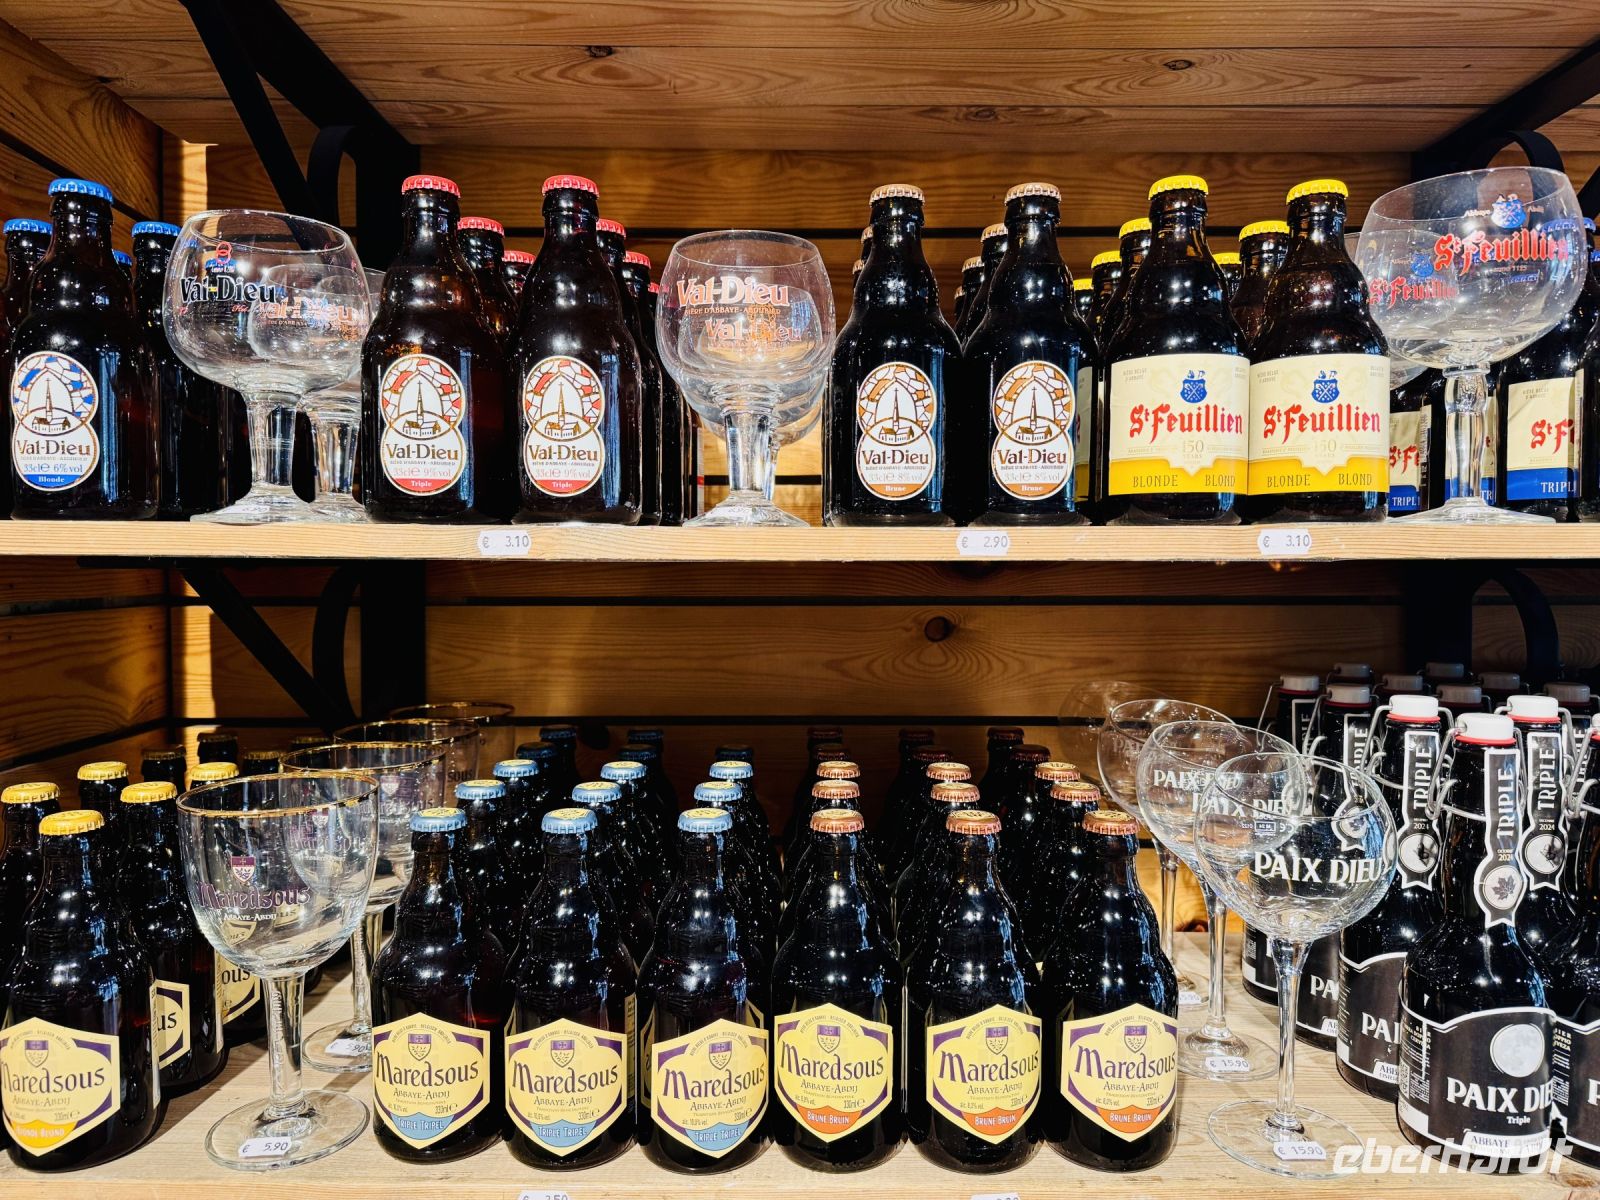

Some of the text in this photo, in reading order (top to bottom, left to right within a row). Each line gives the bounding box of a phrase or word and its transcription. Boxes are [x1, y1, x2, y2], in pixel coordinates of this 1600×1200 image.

[1458, 228, 1569, 276] Feuillien
[180, 275, 275, 303] Val-Dieu
[677, 276, 789, 307] Val-Dieu
[1150, 404, 1242, 444] Feuillien
[1282, 404, 1380, 444] Feuillien
[17, 440, 90, 455] Val-Dieu
[386, 444, 458, 460] Val-Dieu
[529, 445, 598, 461] Val-Dieu
[862, 450, 929, 464] Val-Dieu
[998, 449, 1066, 464] Val-Dieu
[69, 465, 83, 473] vol
[1133, 475, 1236, 488] BLONDE BLOND
[1267, 473, 1372, 488] BLONDE BLOND
[1540, 481, 1576, 494] TRIPL
[1391, 496, 1420, 506] TRIPL
[482, 535, 529, 548] € 3.10
[961, 536, 1008, 548] € 2.90
[1263, 534, 1310, 547] € 3.10
[1413, 745, 1432, 810] TRIPLE
[1538, 748, 1556, 810] TRIPLE
[1497, 768, 1515, 839] TRIPLE
[1539, 823, 1555, 831] 2024
[1254, 852, 1382, 884] PAIX DIEU
[199, 882, 310, 909] Maredsous
[1310, 974, 1339, 1000] PA
[1361, 1012, 1400, 1044] PAI
[1415, 1026, 1431, 1037] BIR
[781, 1041, 884, 1080] Maredsous
[938, 1050, 1039, 1084] Maredsous
[1075, 1045, 1175, 1079] Maredsous
[1221, 1059, 1248, 1068] 15.90
[376, 1052, 478, 1087] Maredsous
[512, 1060, 618, 1095] Maredsous
[663, 1064, 765, 1100] Maredsous
[1446, 1077, 1518, 1113] PAIX
[1524, 1078, 1553, 1112] DIE
[807, 1110, 849, 1125] BRUNE BRUIN
[975, 1114, 1016, 1126] BRUNE BRUIN
[1110, 1113, 1152, 1123] BRUNE BRUIN
[1506, 1116, 1530, 1125] Triple
[421, 1120, 445, 1131] TRIPEL
[538, 1126, 588, 1137] TRIPLE TRIPEL
[695, 1128, 742, 1142] TRIPLE TRIPEL
[1471, 1135, 1509, 1148] ABBAYE
[242, 1142, 288, 1153] € 5.90
[1278, 1146, 1323, 1156] € 15.90
